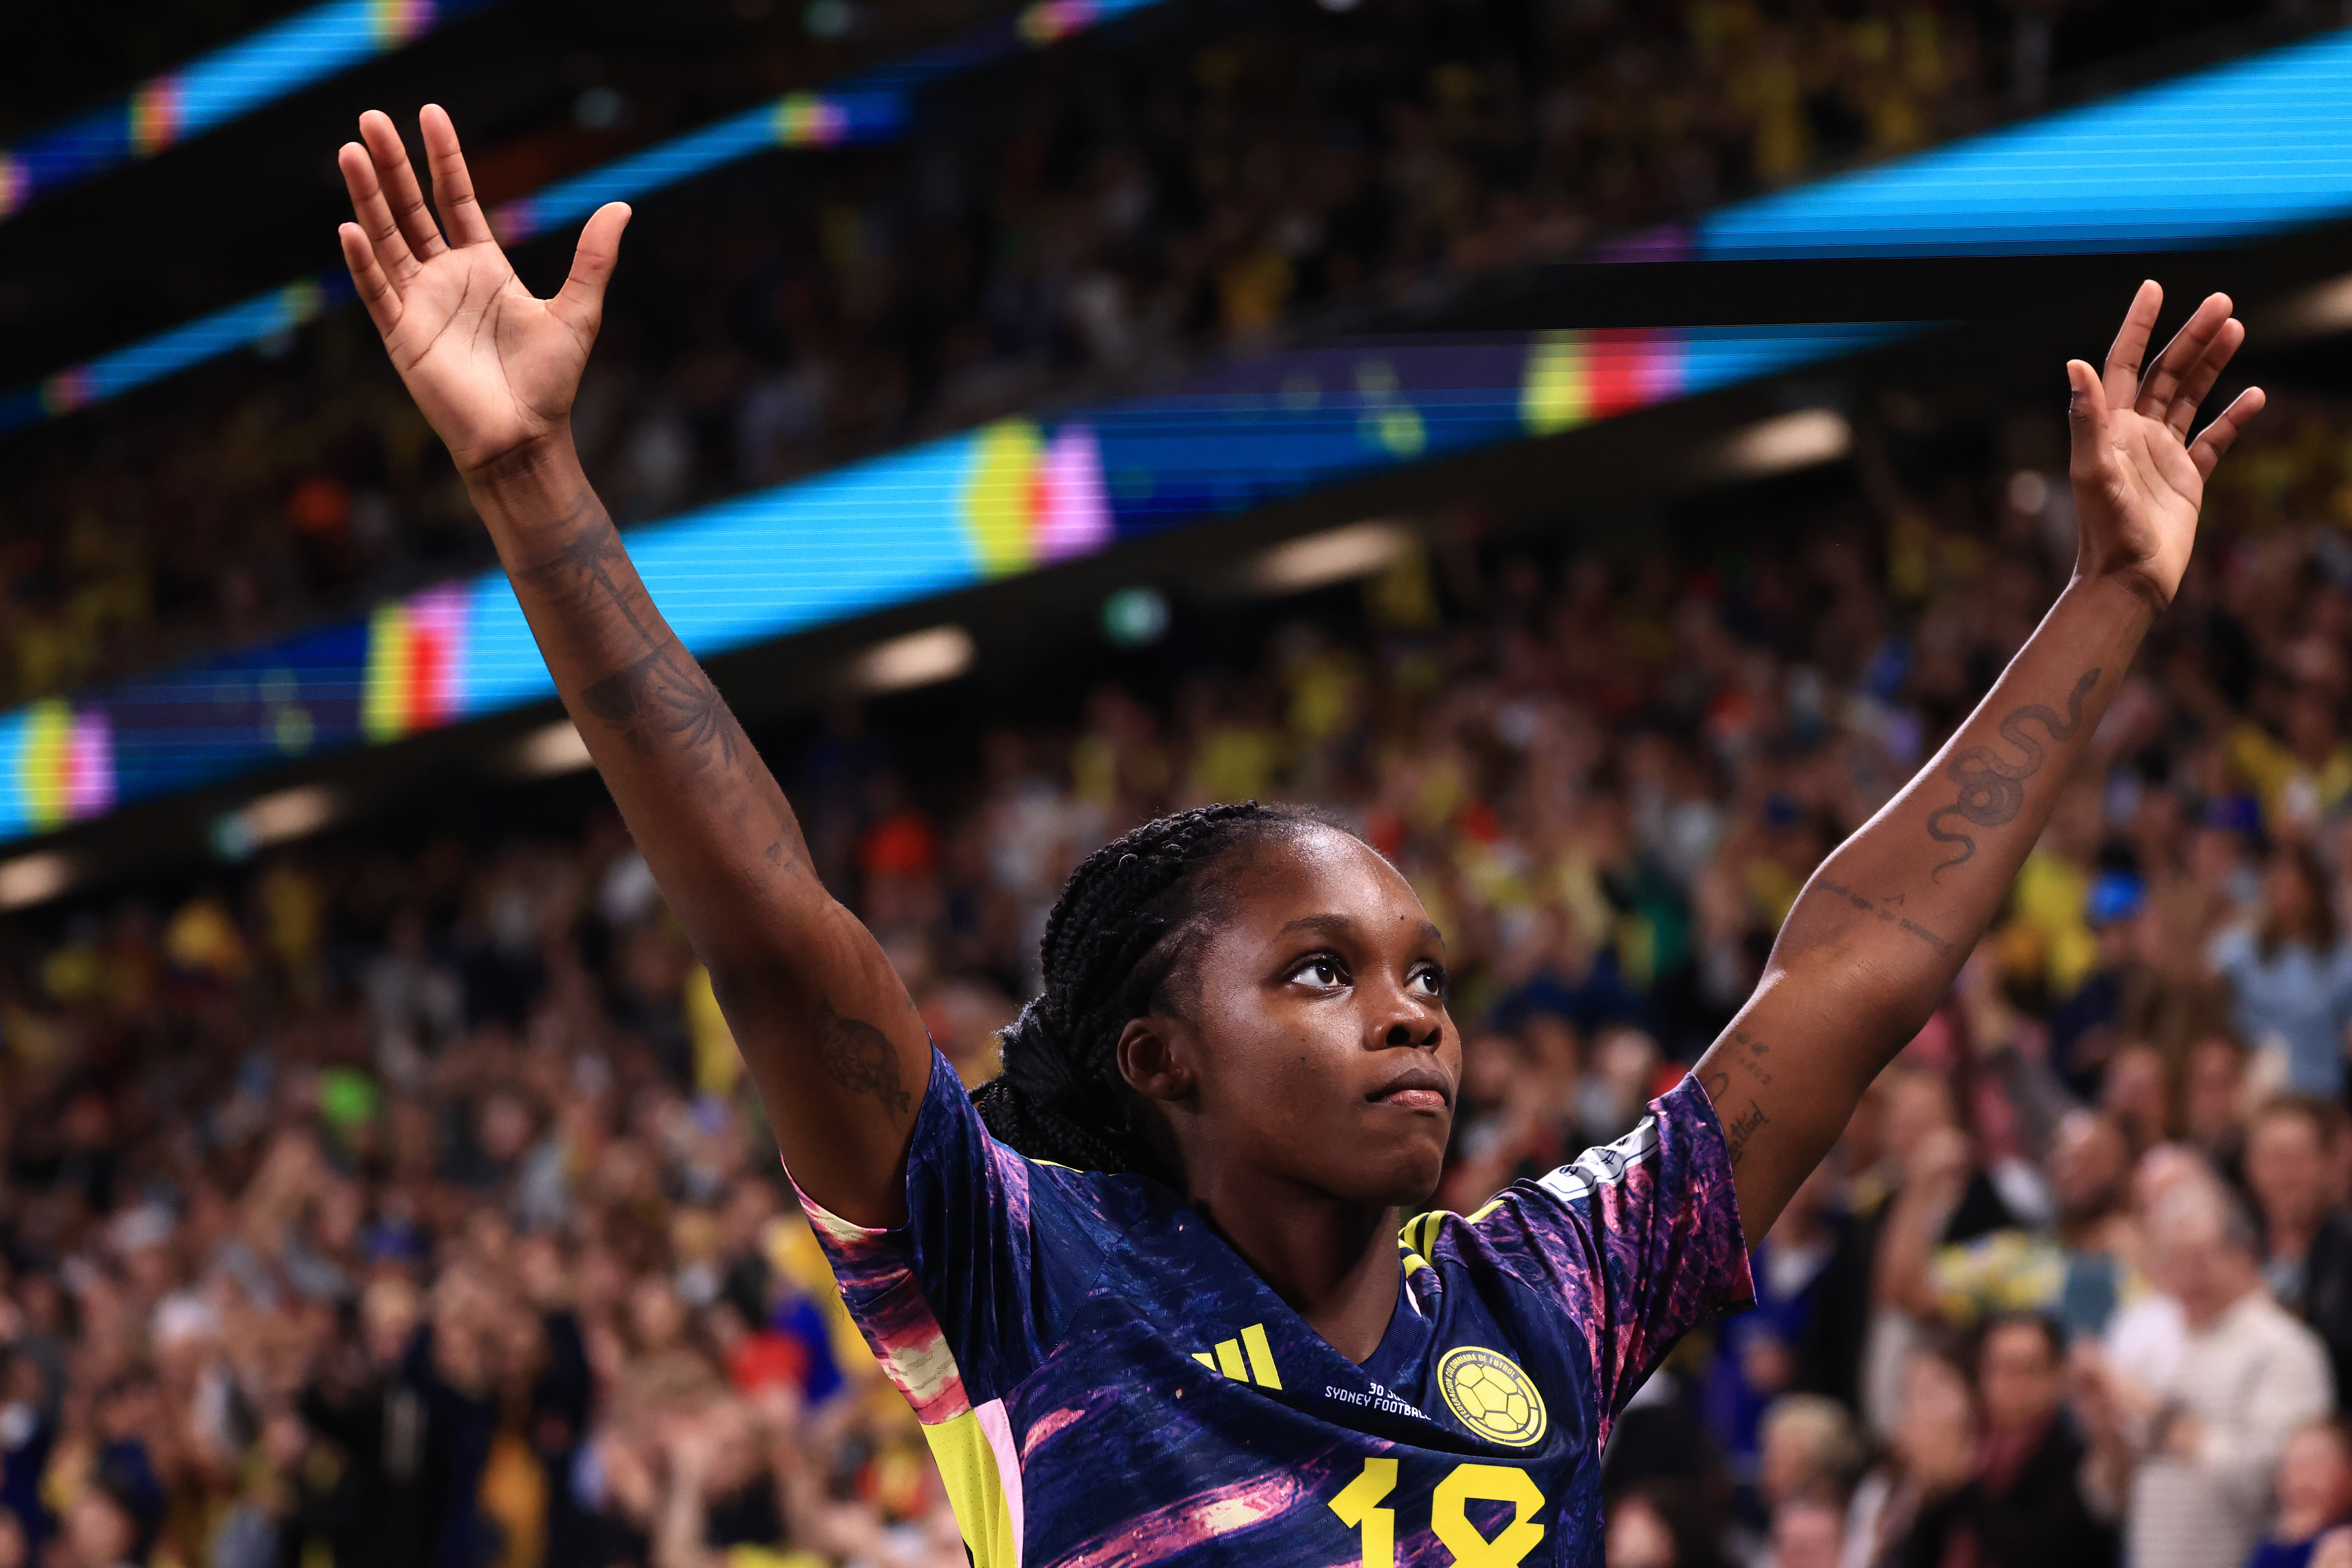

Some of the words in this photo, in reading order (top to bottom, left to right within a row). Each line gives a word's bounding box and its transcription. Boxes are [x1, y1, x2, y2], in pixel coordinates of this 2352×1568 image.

[1445, 1354, 1477, 1378] COLOMBIANA
[1478, 1354, 1488, 1363] DE
[1489, 1357, 1516, 1378] FUTBOL
[1325, 1386, 1371, 1407] SYDNEY
[1369, 1383, 1384, 1396] 30
[1445, 1377, 1470, 1418] FEDERACION
[1327, 1457, 1545, 1568] 18
